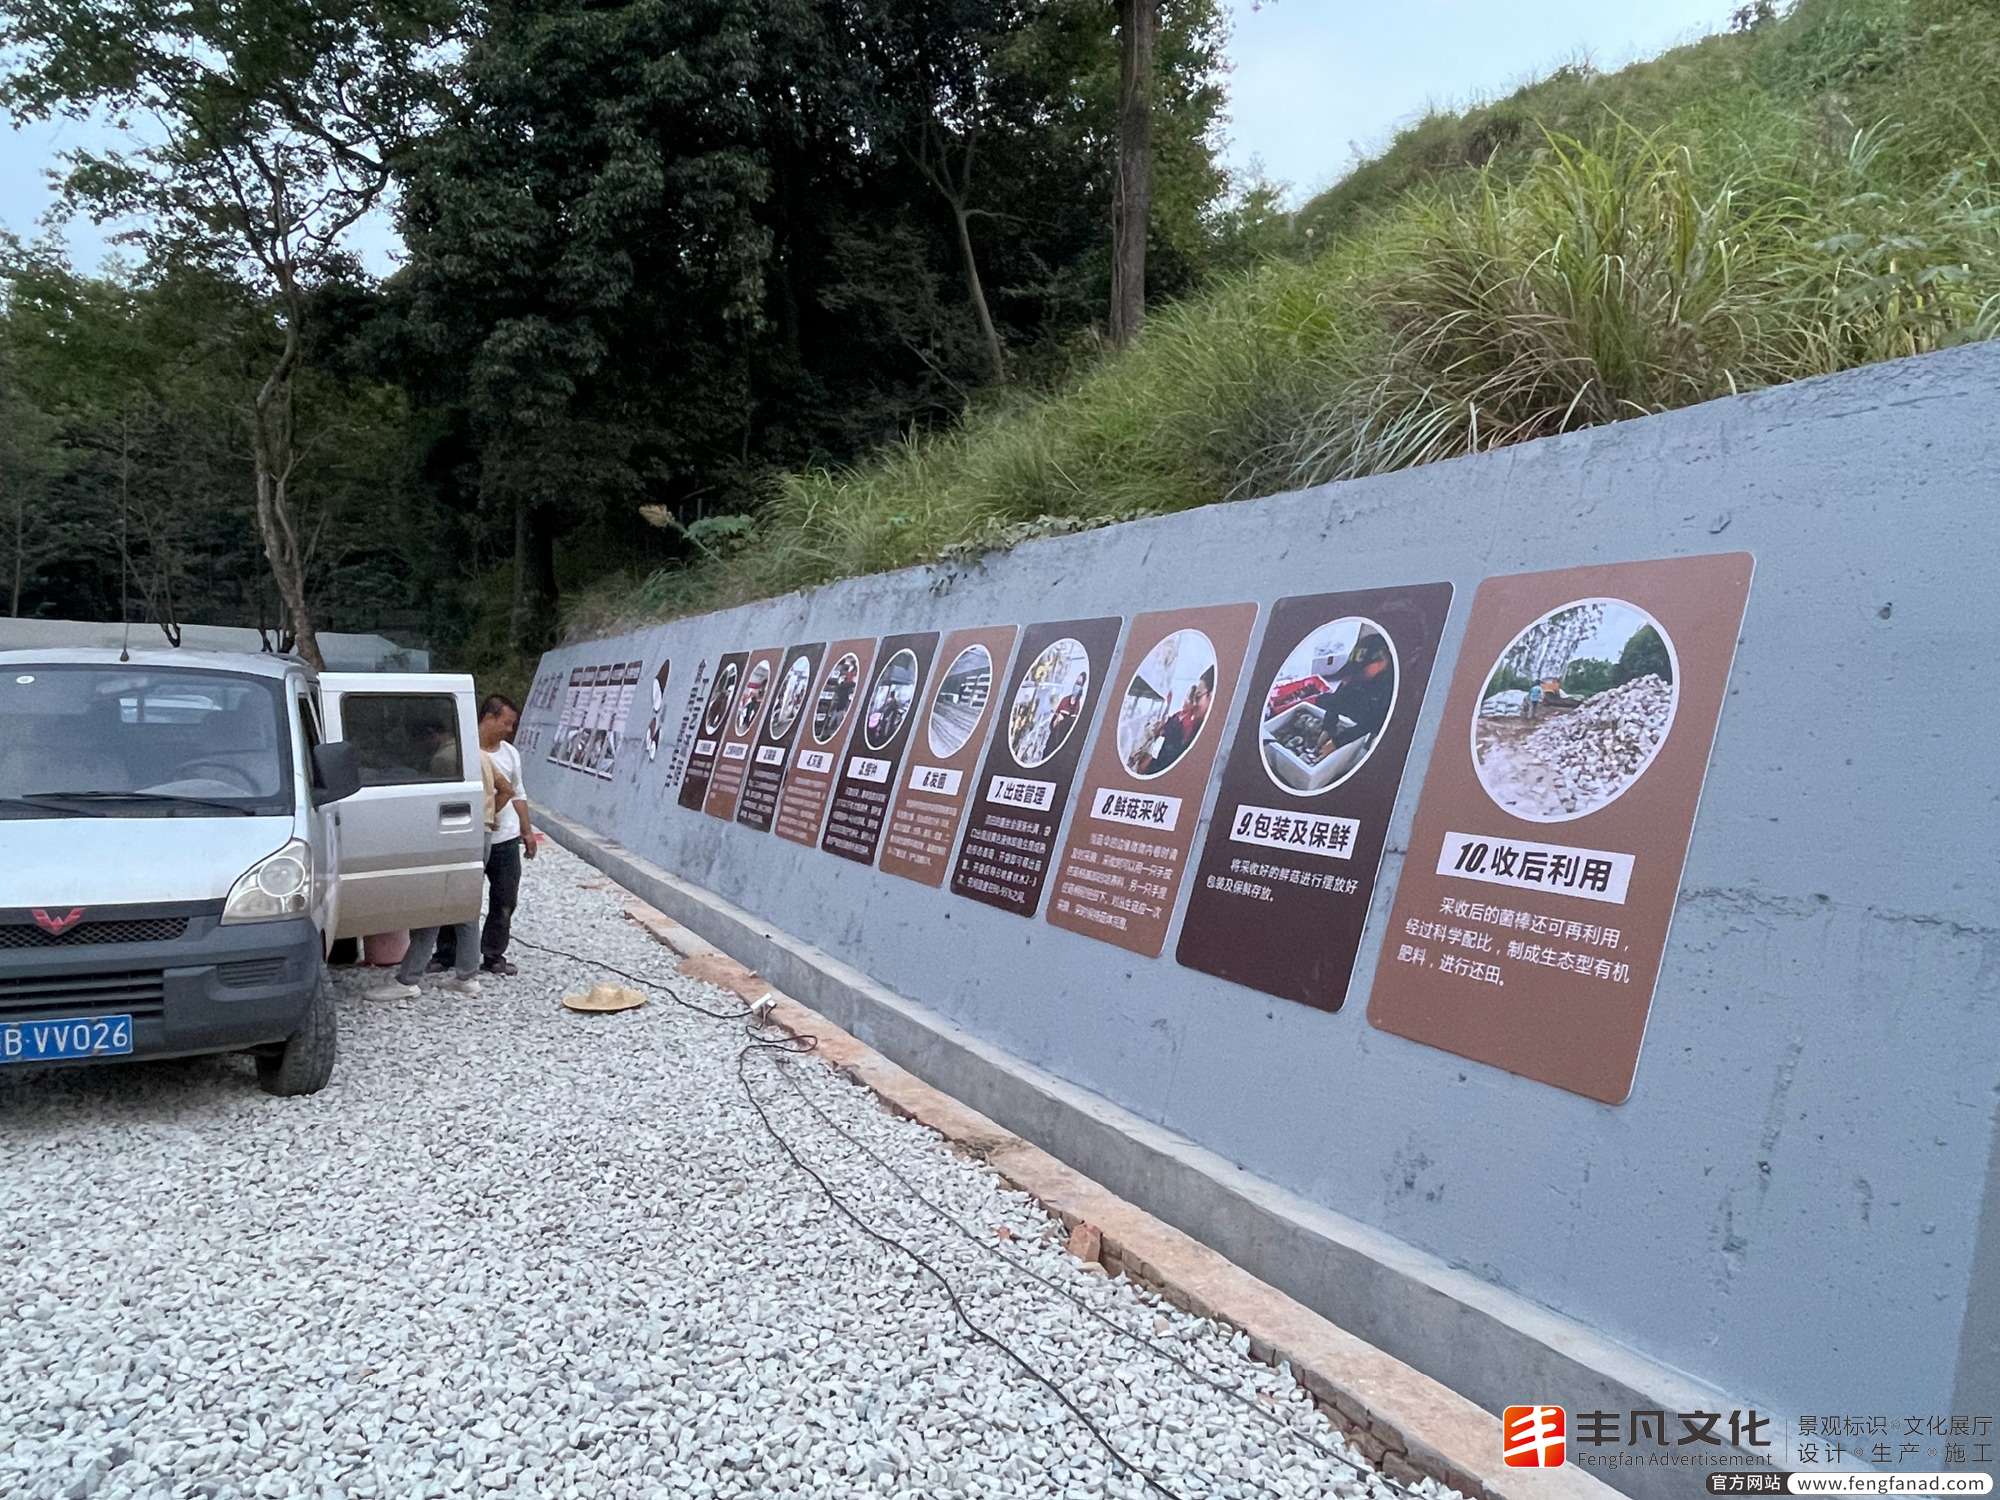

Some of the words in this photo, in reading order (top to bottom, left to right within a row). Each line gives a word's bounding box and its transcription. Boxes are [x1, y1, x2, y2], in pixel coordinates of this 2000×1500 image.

[1101, 794, 1168, 823] 8.鲜菇采收
[1237, 812, 1351, 851] 9.包装及保鲜
[1454, 842, 1613, 892] 10.收后利用
[1206, 875, 1274, 902] 包装及保鲜存放。
[0, 1022, 128, 1056] B·VV026
